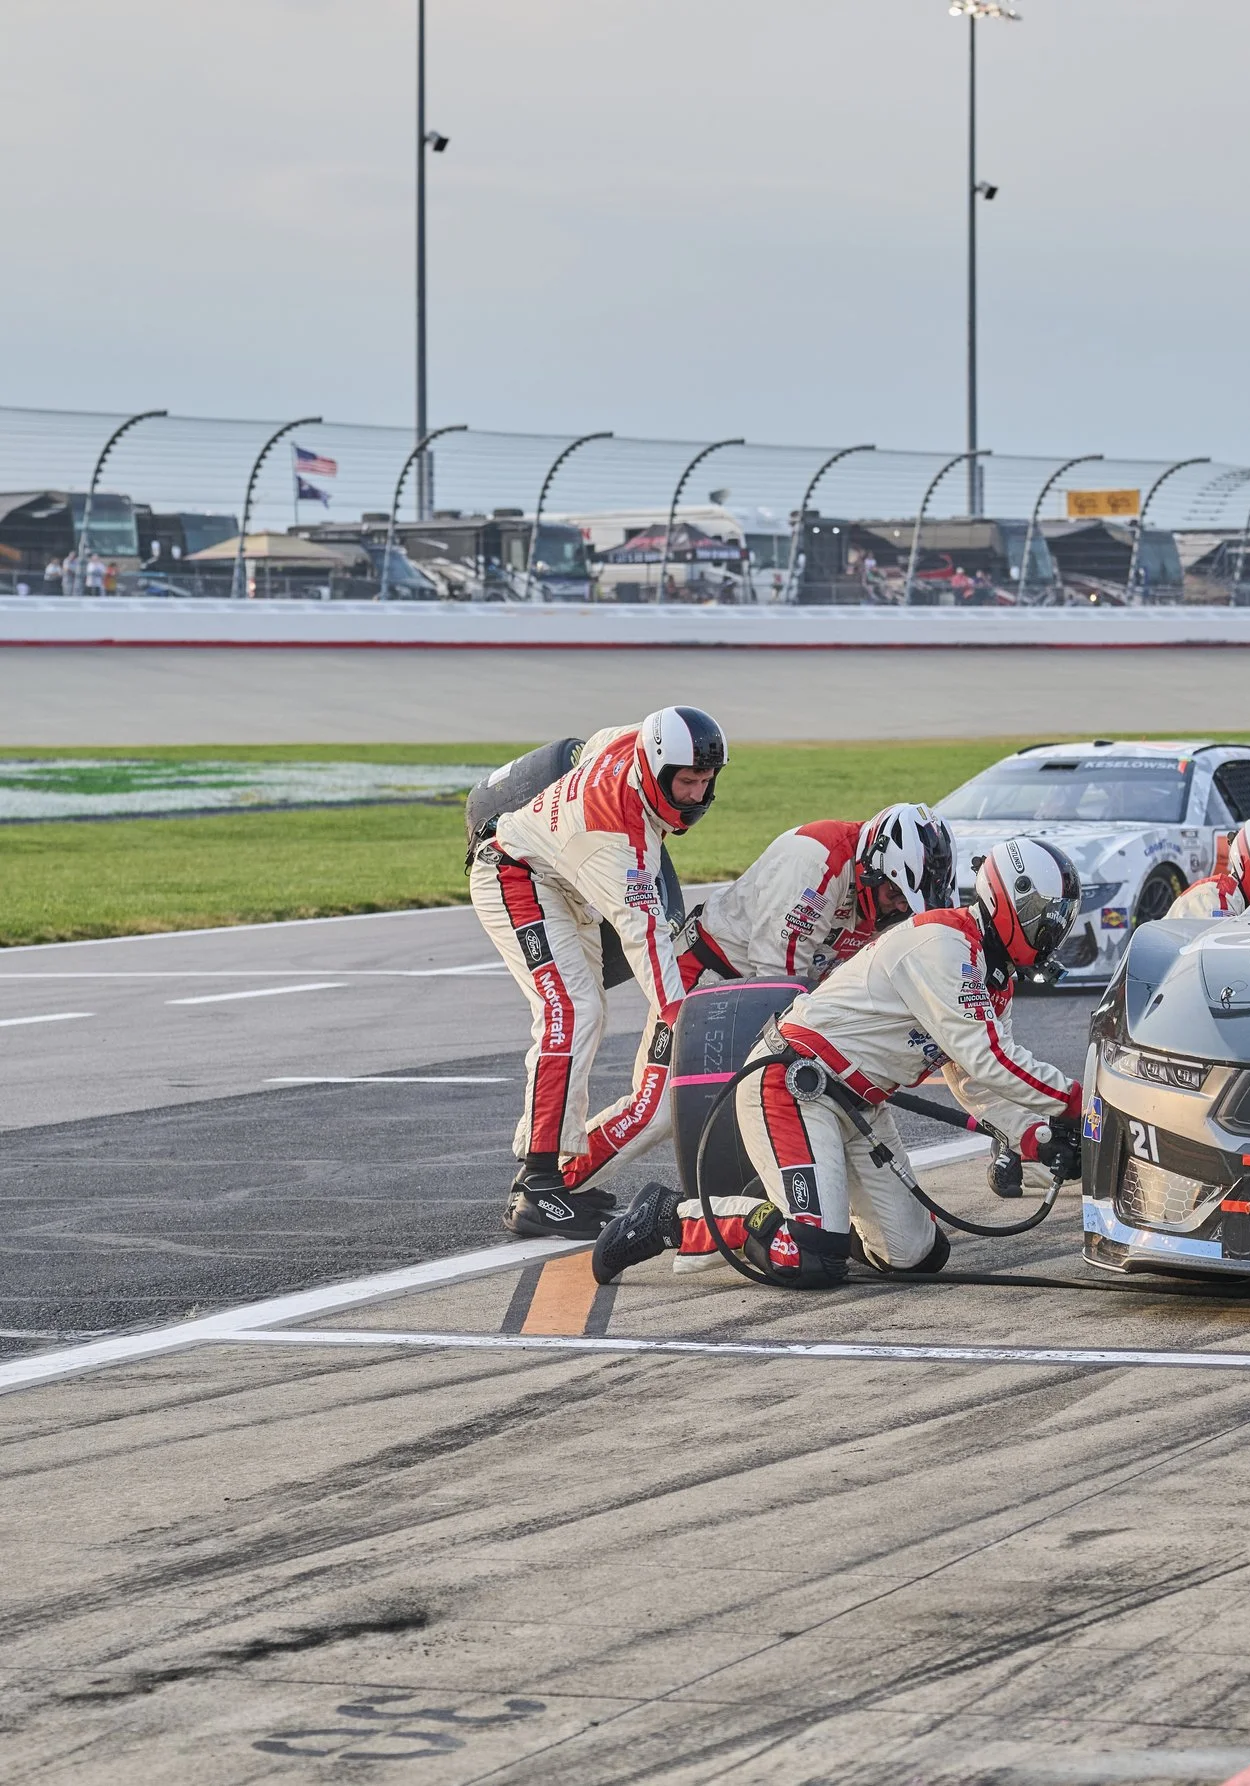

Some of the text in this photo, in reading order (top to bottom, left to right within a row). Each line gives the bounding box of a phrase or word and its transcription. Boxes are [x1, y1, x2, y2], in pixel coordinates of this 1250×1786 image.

[1084, 761, 1177, 770] KESELOWSK
[533, 791, 545, 814] RD
[551, 773, 568, 832] ROTHERS
[627, 884, 654, 892] FORD
[626, 895, 653, 903] LINCOLN
[795, 904, 821, 919] FORD
[786, 915, 813, 930] LINCOLN
[527, 935, 540, 957] Ford
[962, 982, 986, 990] FORD
[540, 971, 565, 1046] Motorcraft
[708, 1001, 729, 1020] PN
[1129, 1120, 1160, 1164] 21
[794, 1179, 806, 1204] Ford
[538, 1199, 565, 1216] sparco
